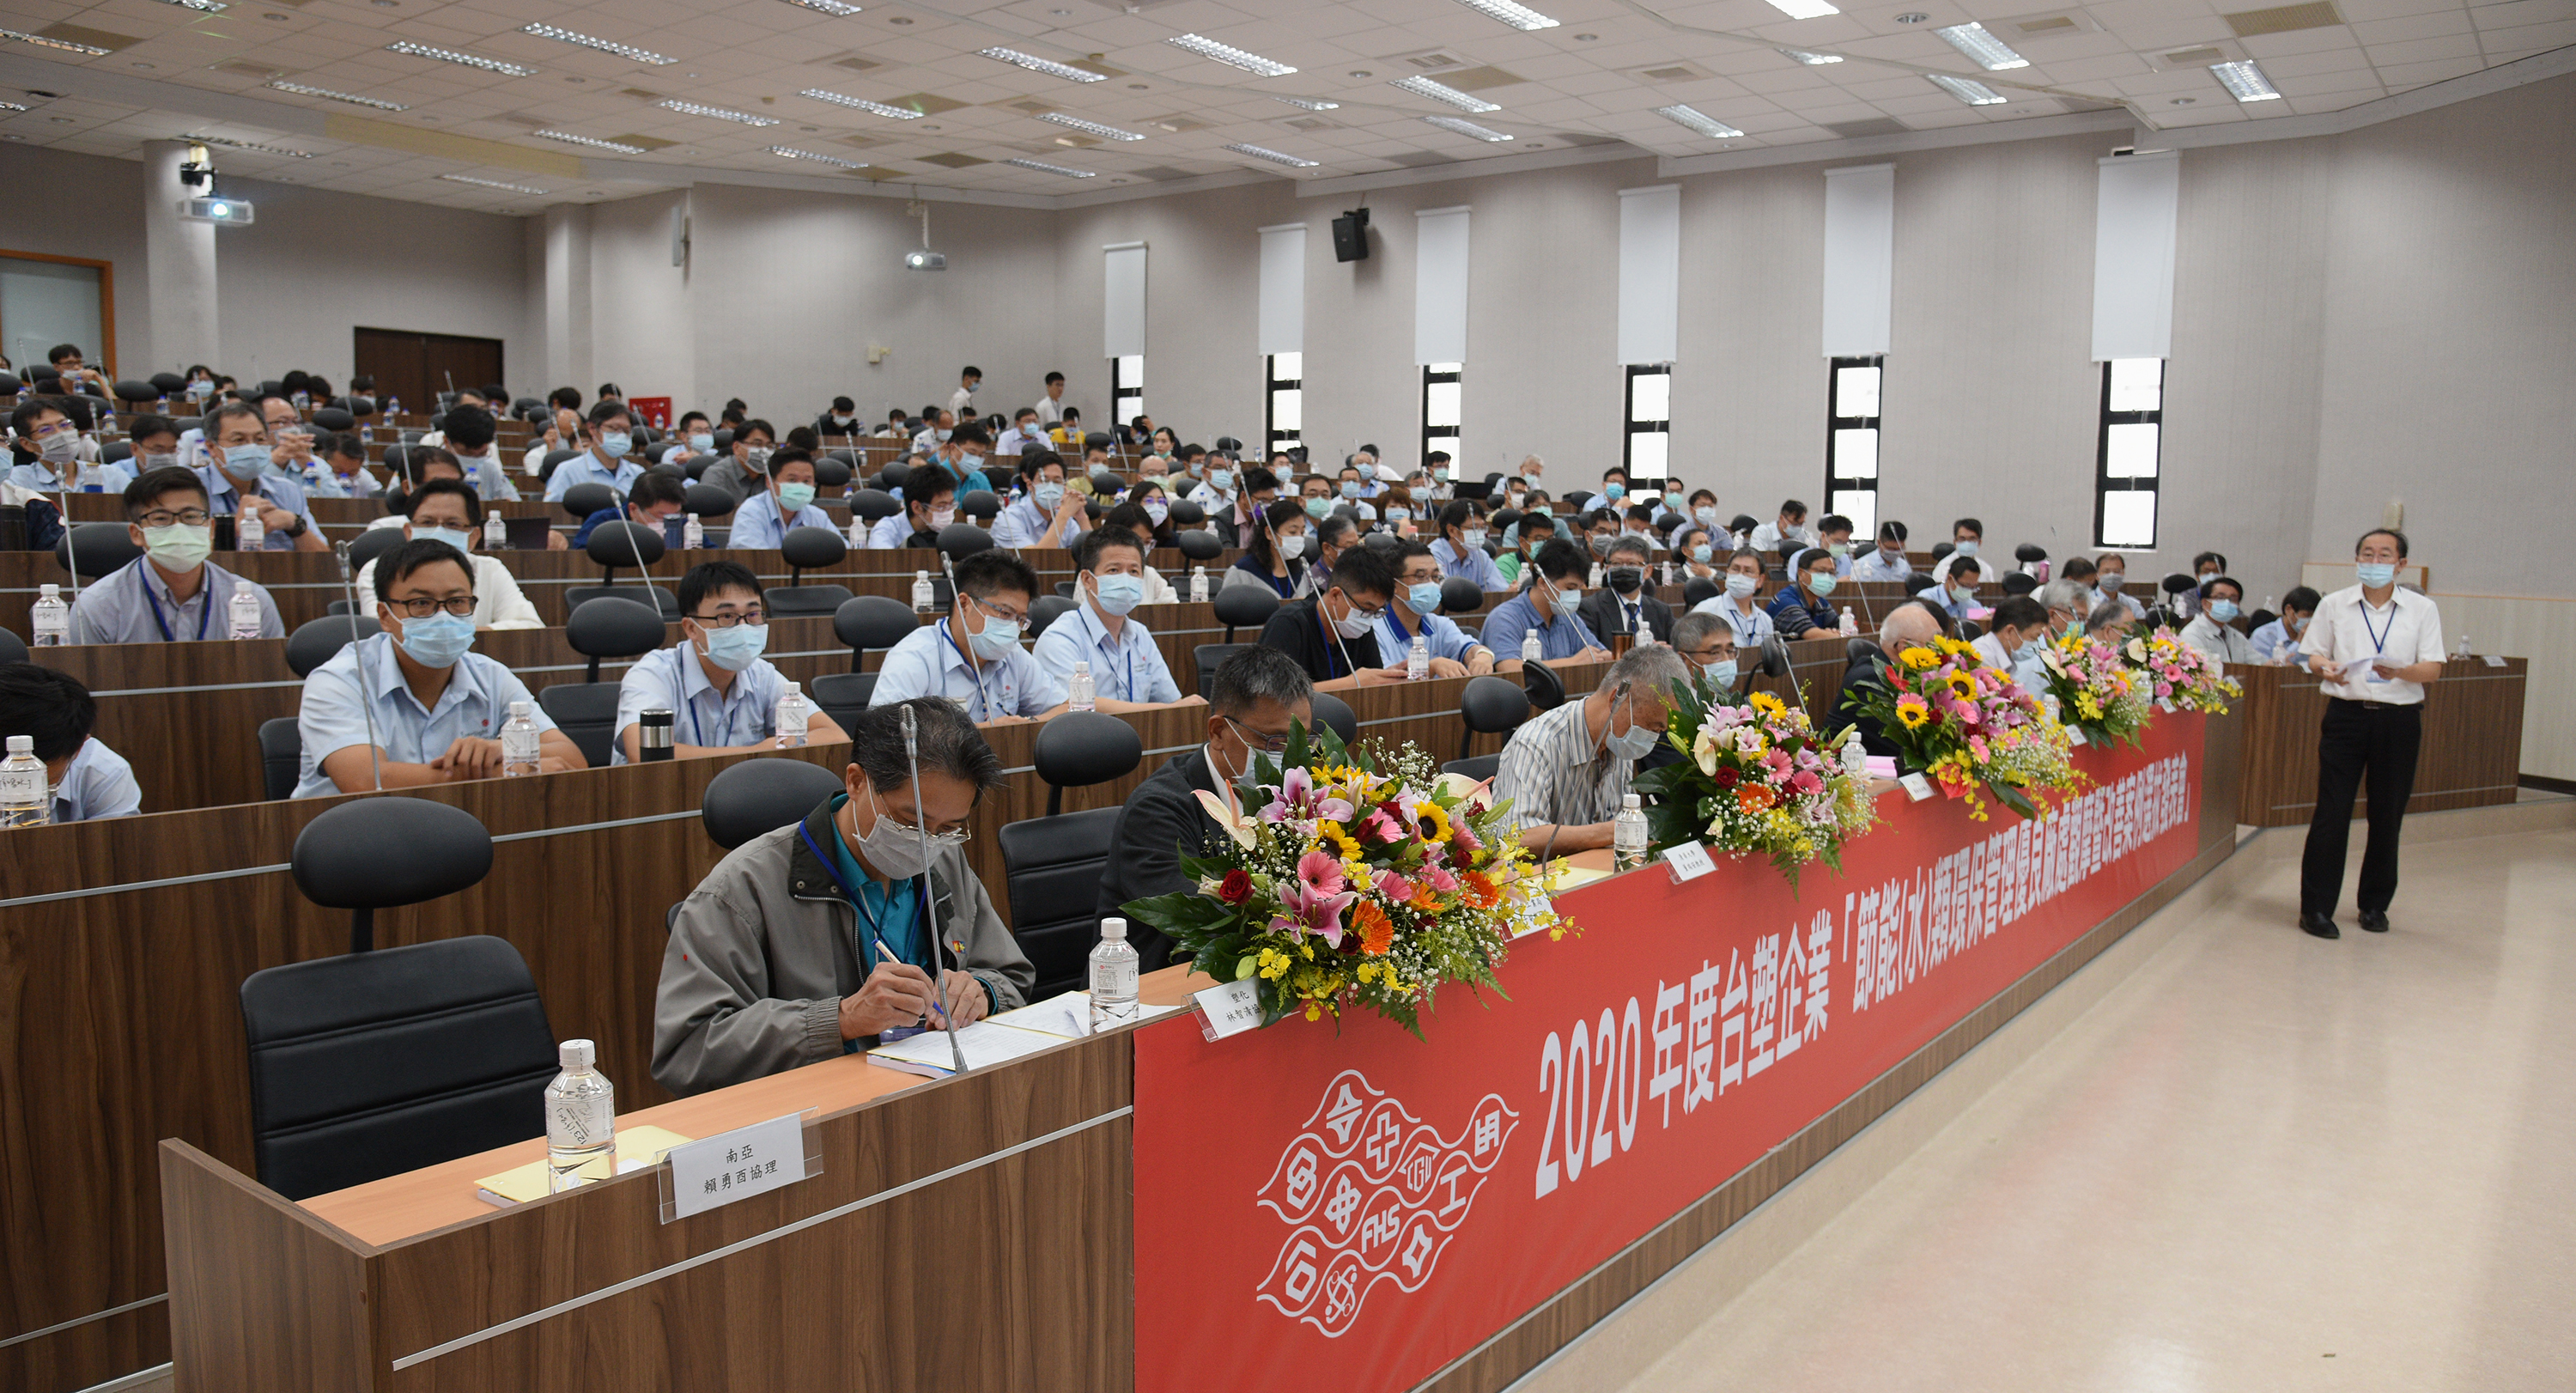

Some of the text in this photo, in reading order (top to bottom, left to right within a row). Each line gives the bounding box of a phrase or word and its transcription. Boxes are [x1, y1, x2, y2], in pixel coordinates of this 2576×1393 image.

[1230, 990, 1250, 1004] 塑化
[1225, 1003, 1265, 1023] 林智清協
[1535, 996, 1641, 1201] 2020
[726, 1144, 754, 1164] 南亞
[1361, 1202, 1400, 1255] FHS
